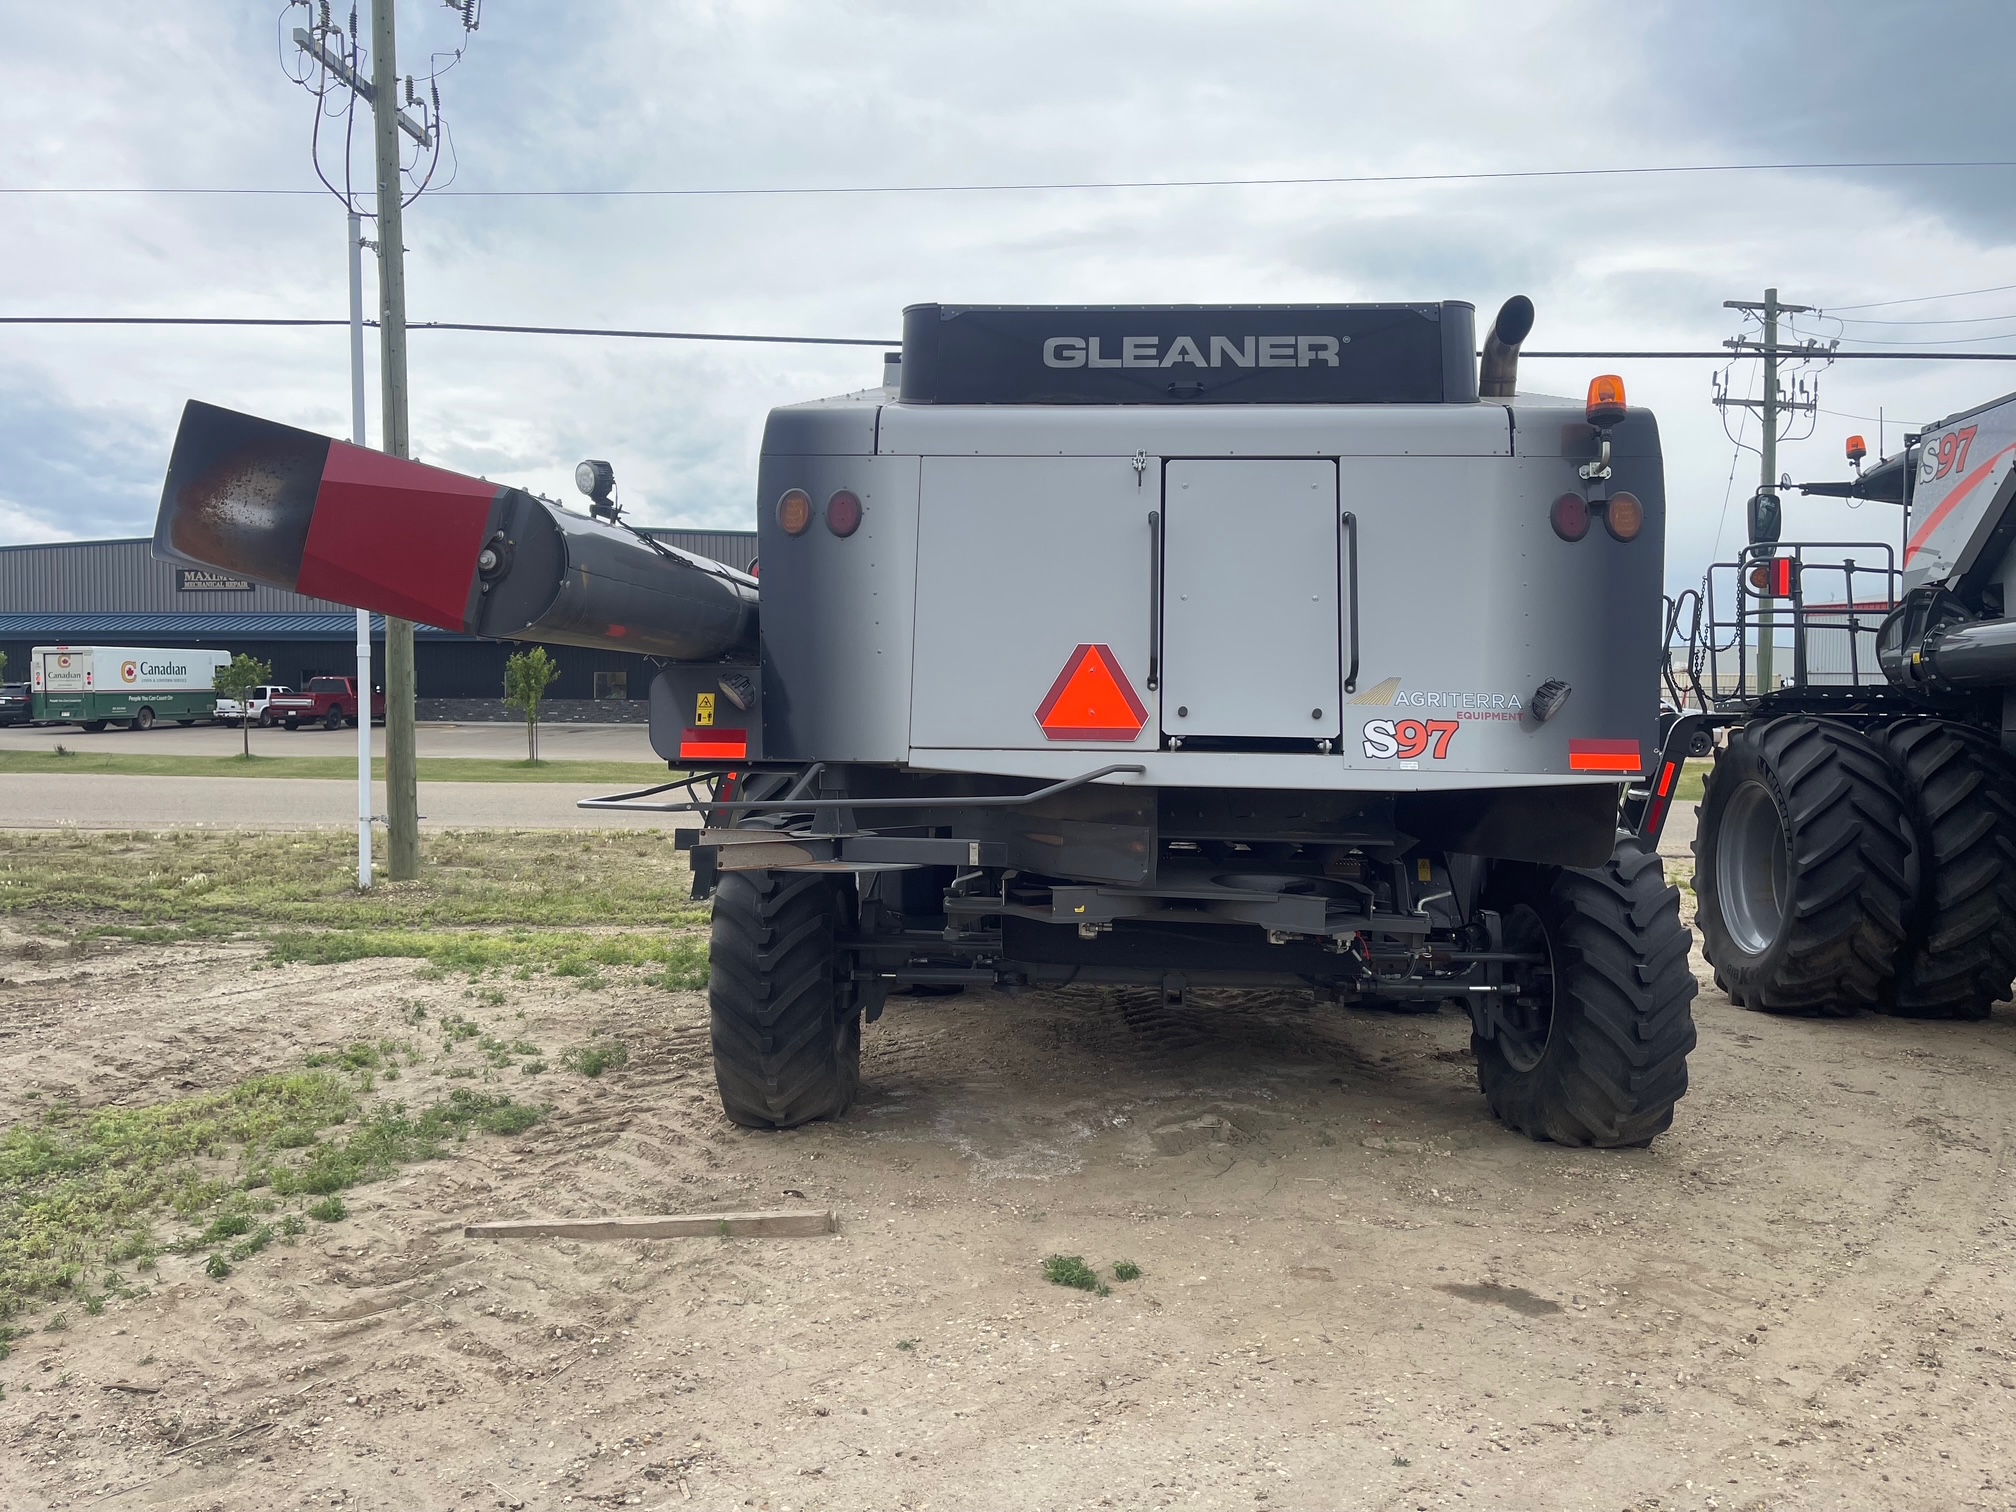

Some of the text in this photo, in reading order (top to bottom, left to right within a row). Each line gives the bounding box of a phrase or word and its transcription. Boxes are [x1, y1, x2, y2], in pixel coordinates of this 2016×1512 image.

[1919, 424, 1978, 485] S97
[184, 571, 237, 581] MAXIM
[48, 671, 81, 679] Canadian
[140, 661, 187, 675] Canadian
[1394, 691, 1523, 709] AGRITERRA
[1456, 711, 1524, 722] EQUIPMENT
[1362, 718, 1460, 760] S97
